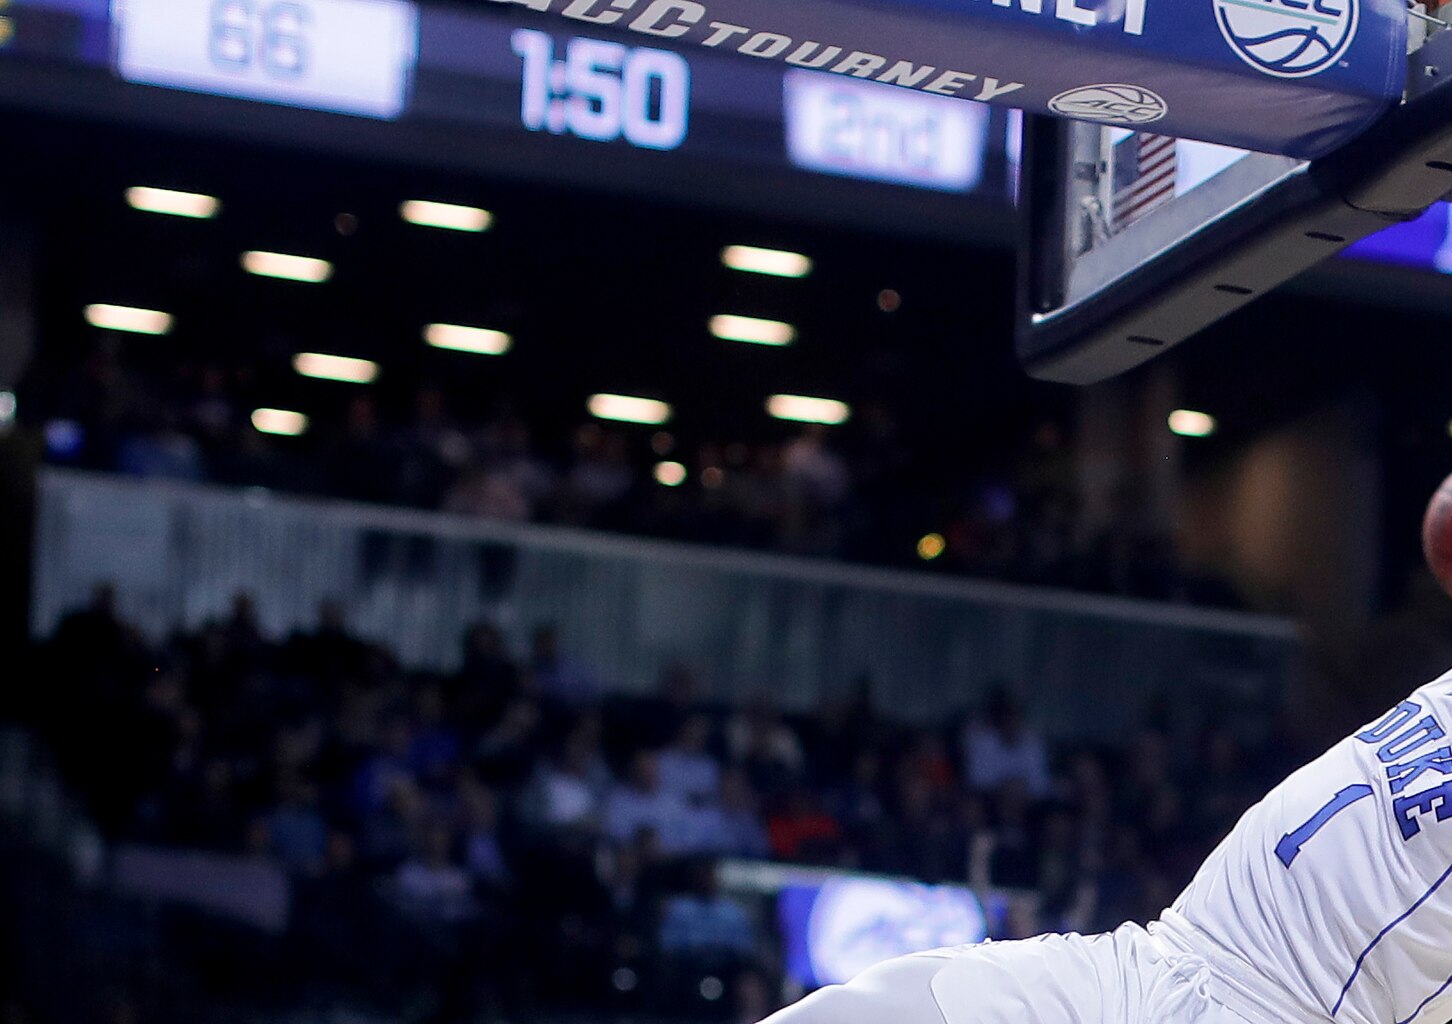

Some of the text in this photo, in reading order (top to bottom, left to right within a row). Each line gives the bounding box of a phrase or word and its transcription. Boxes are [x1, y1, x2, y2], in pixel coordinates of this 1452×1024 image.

[209, 0, 312, 73] 66
[510, 27, 692, 151] 1:50
[1274, 783, 1375, 870] 1
